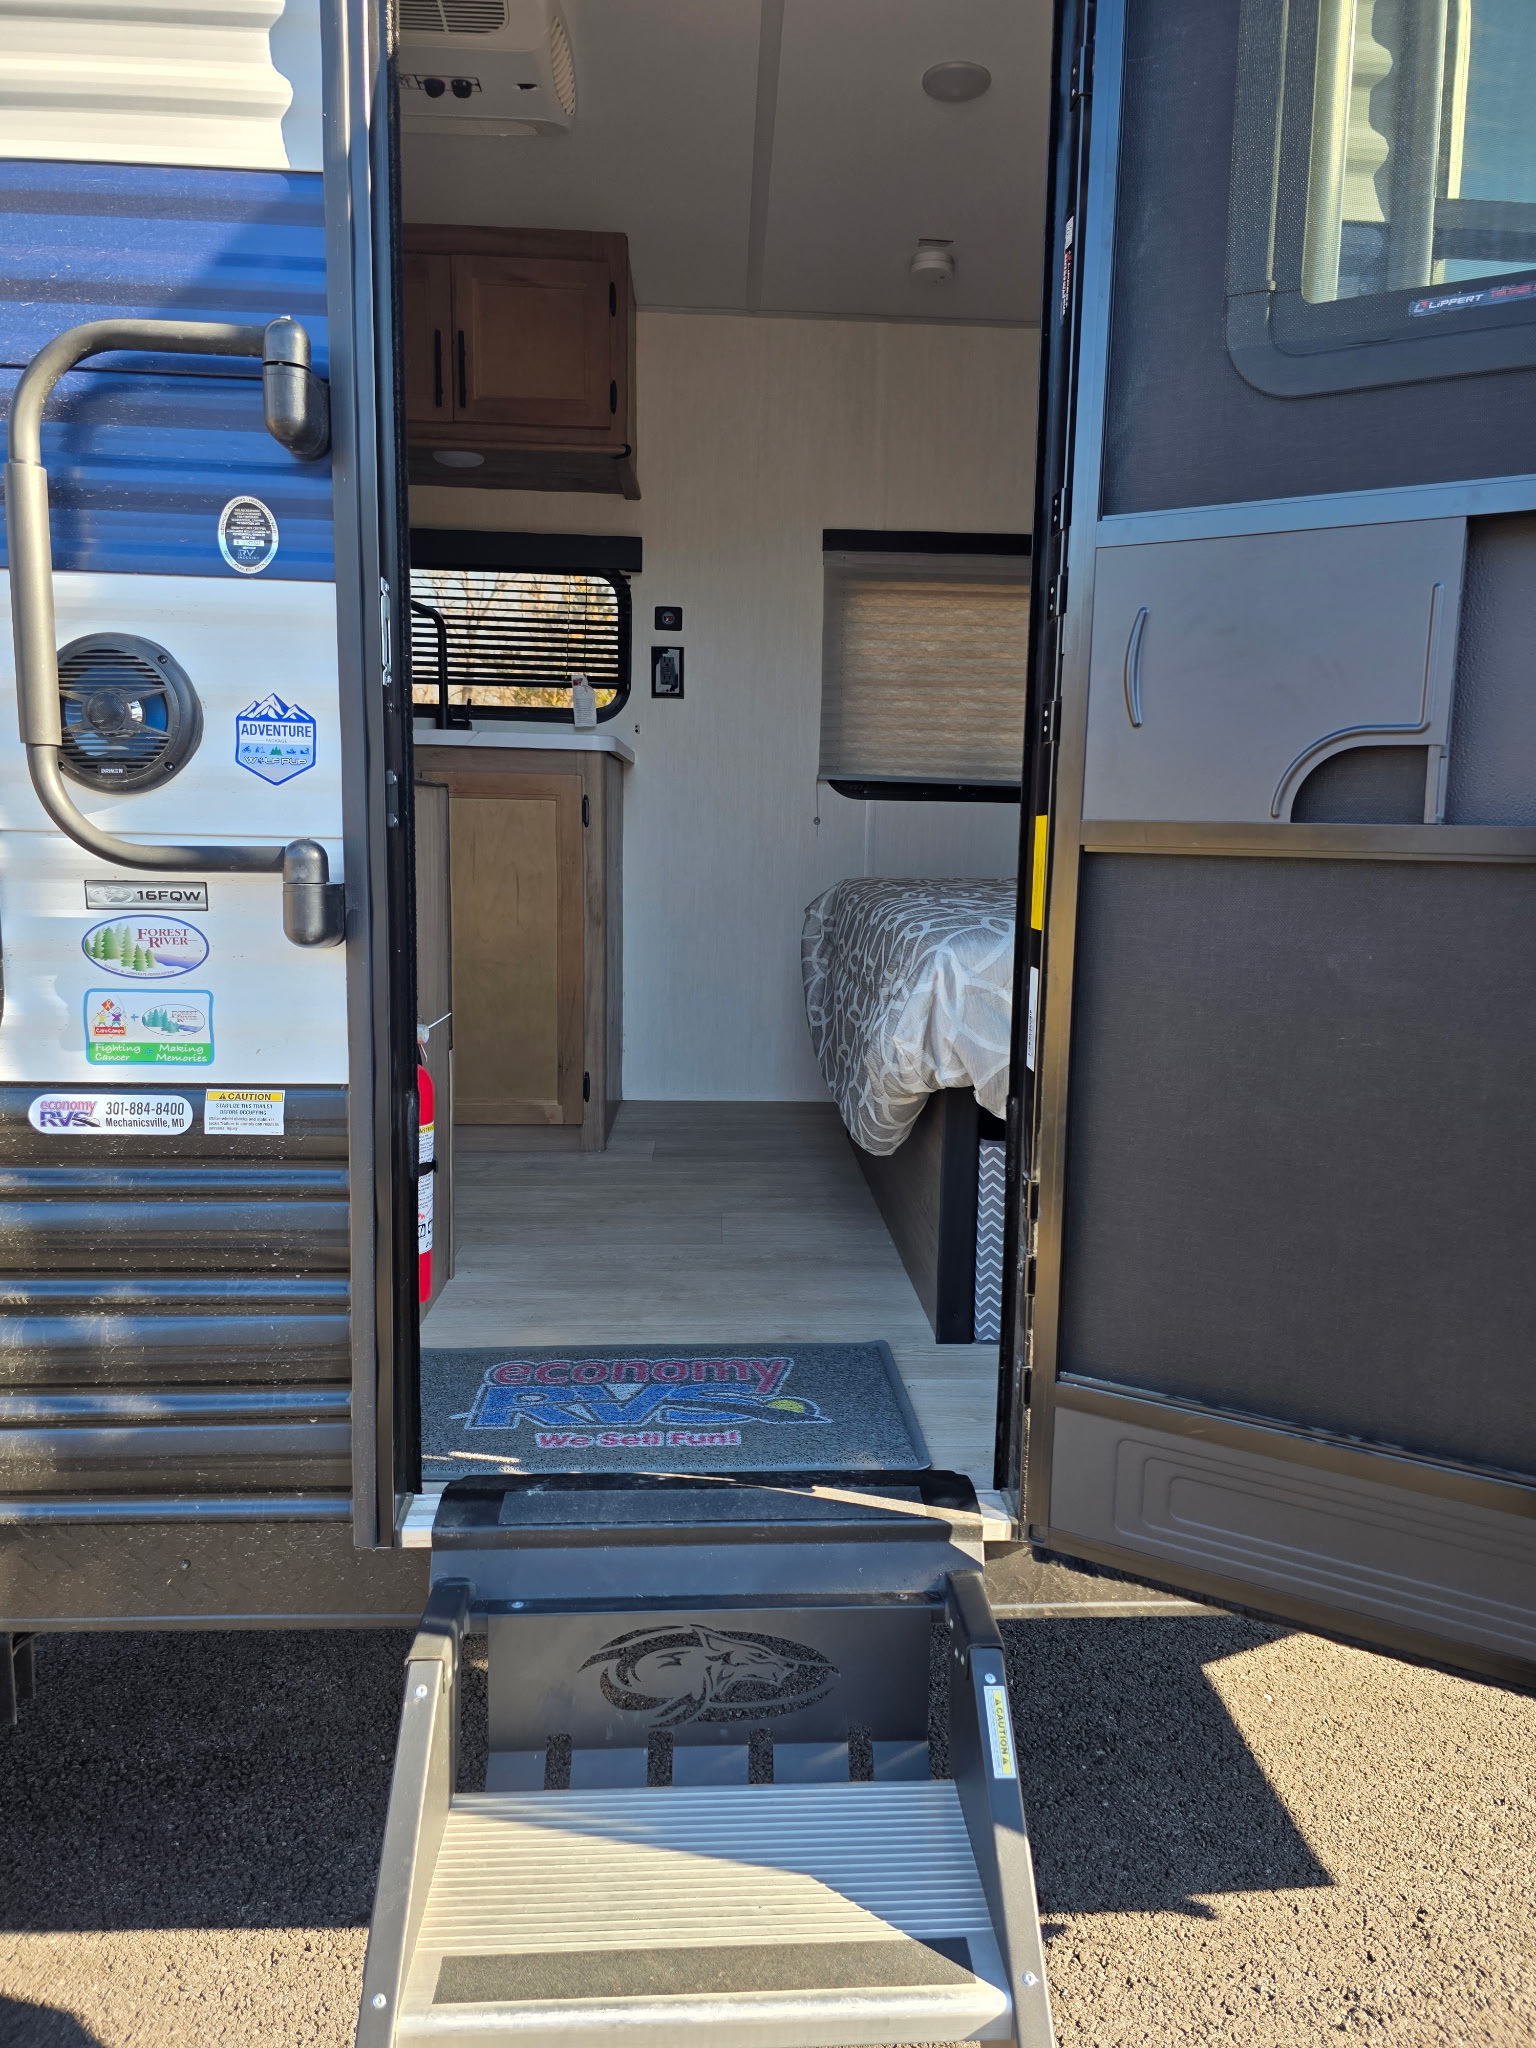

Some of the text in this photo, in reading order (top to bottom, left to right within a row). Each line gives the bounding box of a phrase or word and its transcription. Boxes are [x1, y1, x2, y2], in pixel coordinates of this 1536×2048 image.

[1428, 293, 1484, 309] LIPPERT
[240, 723, 312, 738] ADVENTURE
[136, 890, 201, 902] 16FQW
[136, 928, 190, 940] FOREST
[148, 936, 189, 949] RIVER
[95, 1043, 141, 1053] Fighting
[159, 1044, 204, 1053] Making
[95, 1053, 131, 1061] Cancer
[156, 1053, 208, 1062] Memories
[227, 1093, 272, 1101] CAUTION
[39, 1100, 98, 1116] economy
[105, 1101, 185, 1116] 301-884-8400
[105, 1117, 185, 1129] Mechanicsville, MD
[491, 1358, 789, 1395] economy
[536, 1431, 739, 1448] We Sell Fun!
[996, 1707, 1009, 1755] CAUTION
